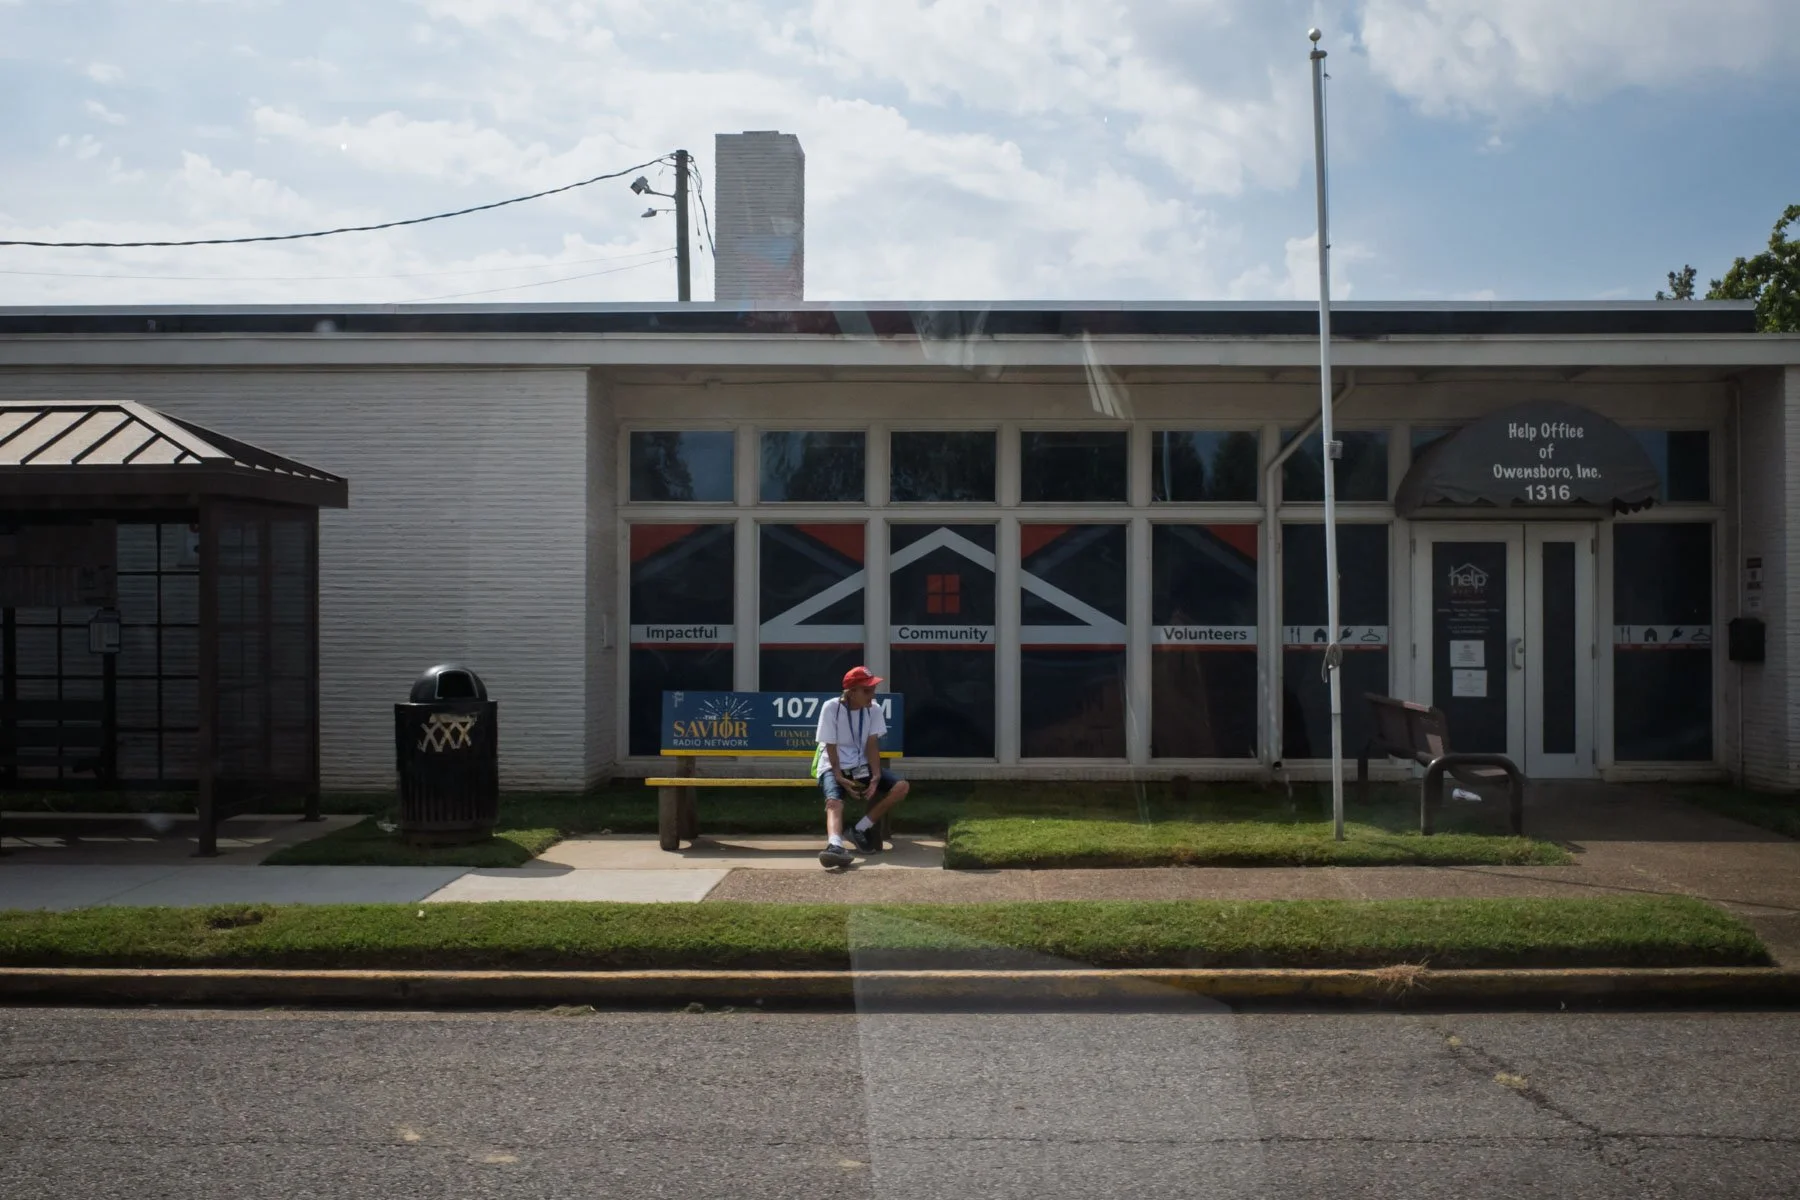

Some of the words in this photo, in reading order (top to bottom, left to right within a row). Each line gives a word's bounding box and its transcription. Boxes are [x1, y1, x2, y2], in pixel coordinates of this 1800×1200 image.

[1508, 422, 1537, 442] Help
[1540, 422, 1584, 439] Office
[1538, 442, 1555, 459] of
[1493, 463, 1574, 480] Owensboro,
[1576, 463, 1602, 479] Inc.
[1525, 484, 1571, 501] 1316
[1449, 565, 1488, 590] help
[646, 626, 718, 642] Impactful
[898, 626, 988, 643] Community
[1163, 627, 1248, 640] Volunteers
[772, 697, 819, 719] 107
[672, 719, 749, 739] SAVIOR
[672, 738, 702, 747] RADIO
[704, 738, 749, 747] NETWORK
